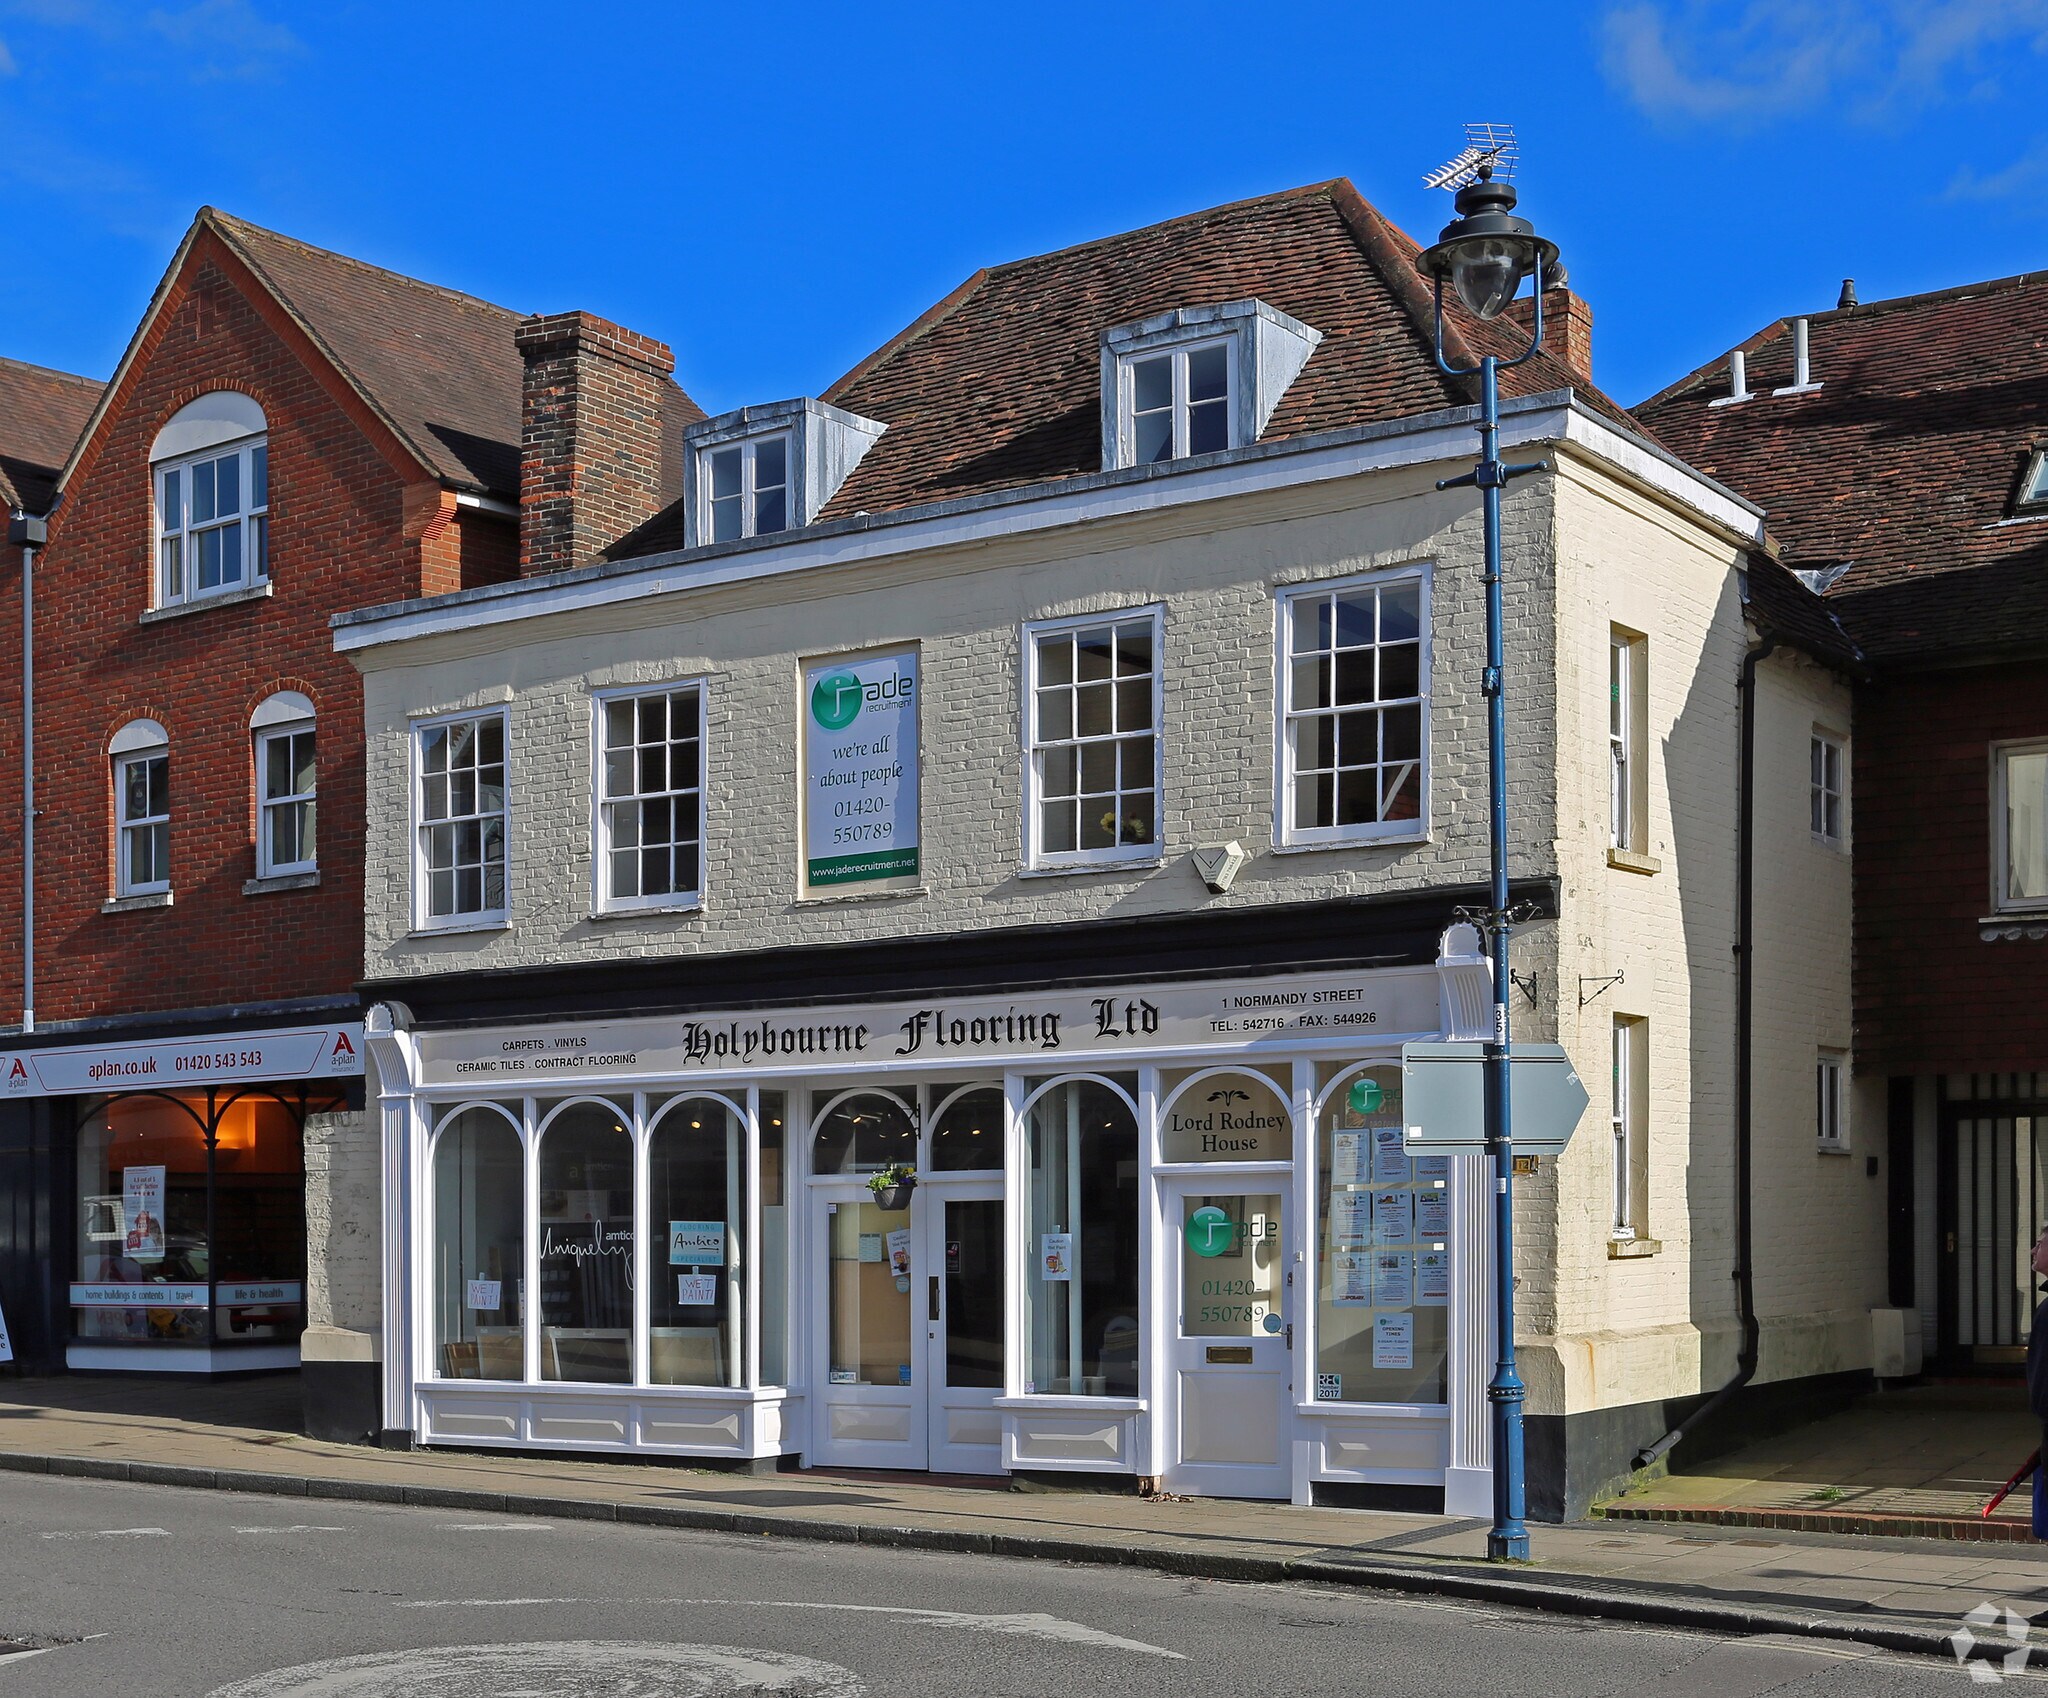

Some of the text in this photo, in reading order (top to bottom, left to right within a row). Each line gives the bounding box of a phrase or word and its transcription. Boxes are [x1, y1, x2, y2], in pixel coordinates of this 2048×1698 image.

[866, 698, 912, 714] recruitment
[832, 735, 890, 760] we're all
[820, 760, 904, 790] about people
[834, 796, 890, 818] 01420-
[833, 822, 892, 844] 550789
[812, 858, 916, 877] www.jaderecruitment.net
[1222, 988, 1363, 1008] 1 NORMANDY STREET
[1210, 1011, 1376, 1032] TEL: 542716 FAX: 544926
[682, 997, 1160, 1064] Holybourne Flooring Ltd
[502, 1038, 587, 1051] CARPETS VINYLS
[89, 1051, 262, 1081] aplan.co.uk 01420 543 543
[332, 1054, 355, 1066] a-plan
[456, 1054, 636, 1072] CERAMIC TILES CONTRACT FLOORING
[8, 1078, 28, 1088] a-plan
[1172, 1111, 1285, 1132] Lord Rodney
[1202, 1135, 1258, 1152] House
[674, 1232, 719, 1249] Amtico
[472, 1284, 496, 1294] WET
[686, 1279, 714, 1288] WET
[86, 1288, 193, 1301] home buildings & contents travel
[235, 1287, 283, 1299] life & health
[682, 1289, 714, 1300] PAINT!
[1200, 1306, 1263, 1322] 550789
